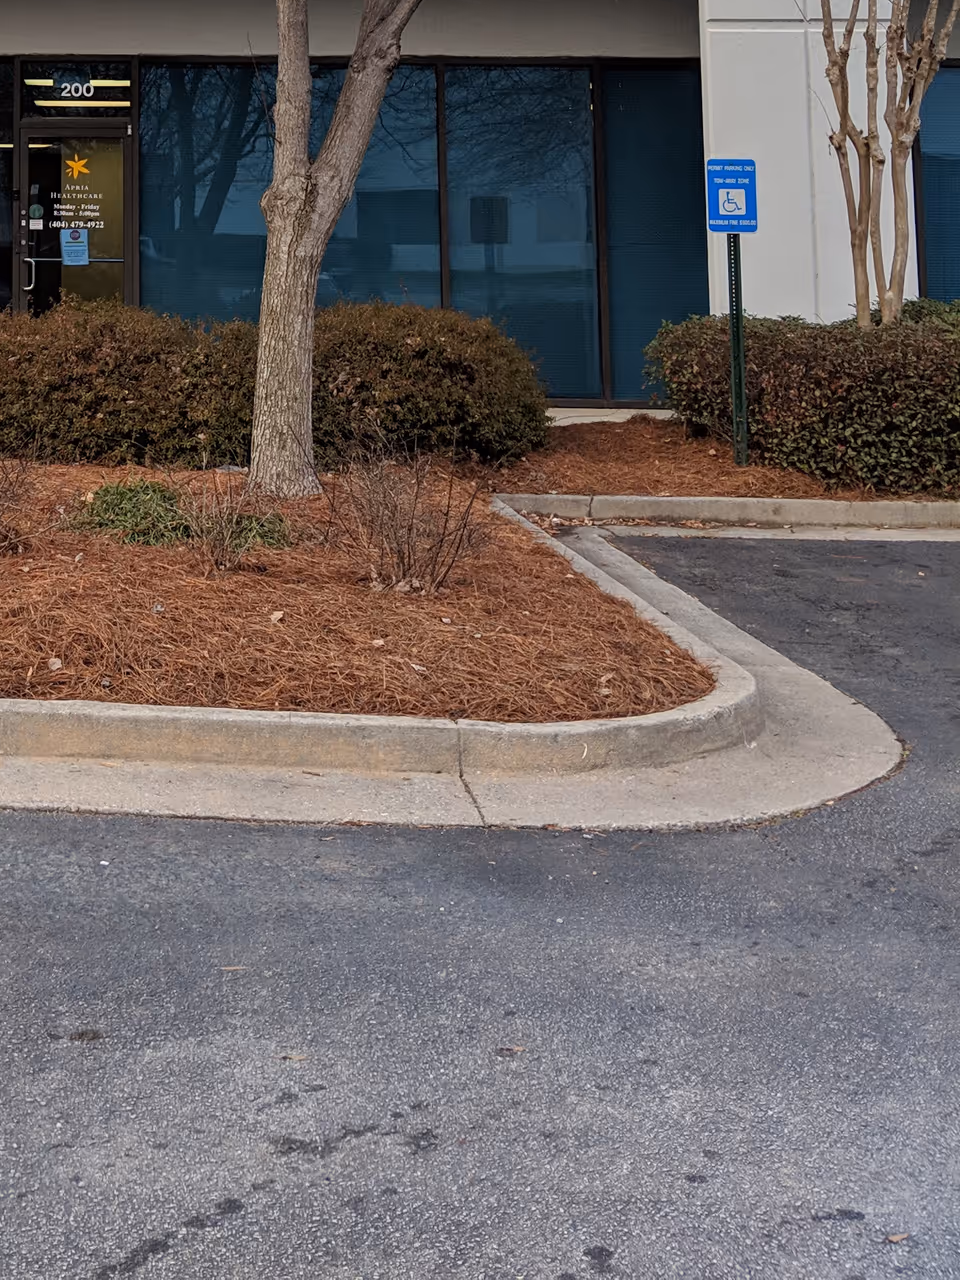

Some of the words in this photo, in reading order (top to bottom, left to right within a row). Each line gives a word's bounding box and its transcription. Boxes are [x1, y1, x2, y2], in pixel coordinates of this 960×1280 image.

[60, 82, 95, 98] 200
[48, 221, 68, 229] (404)
[70, 221, 104, 229] 479-4922
